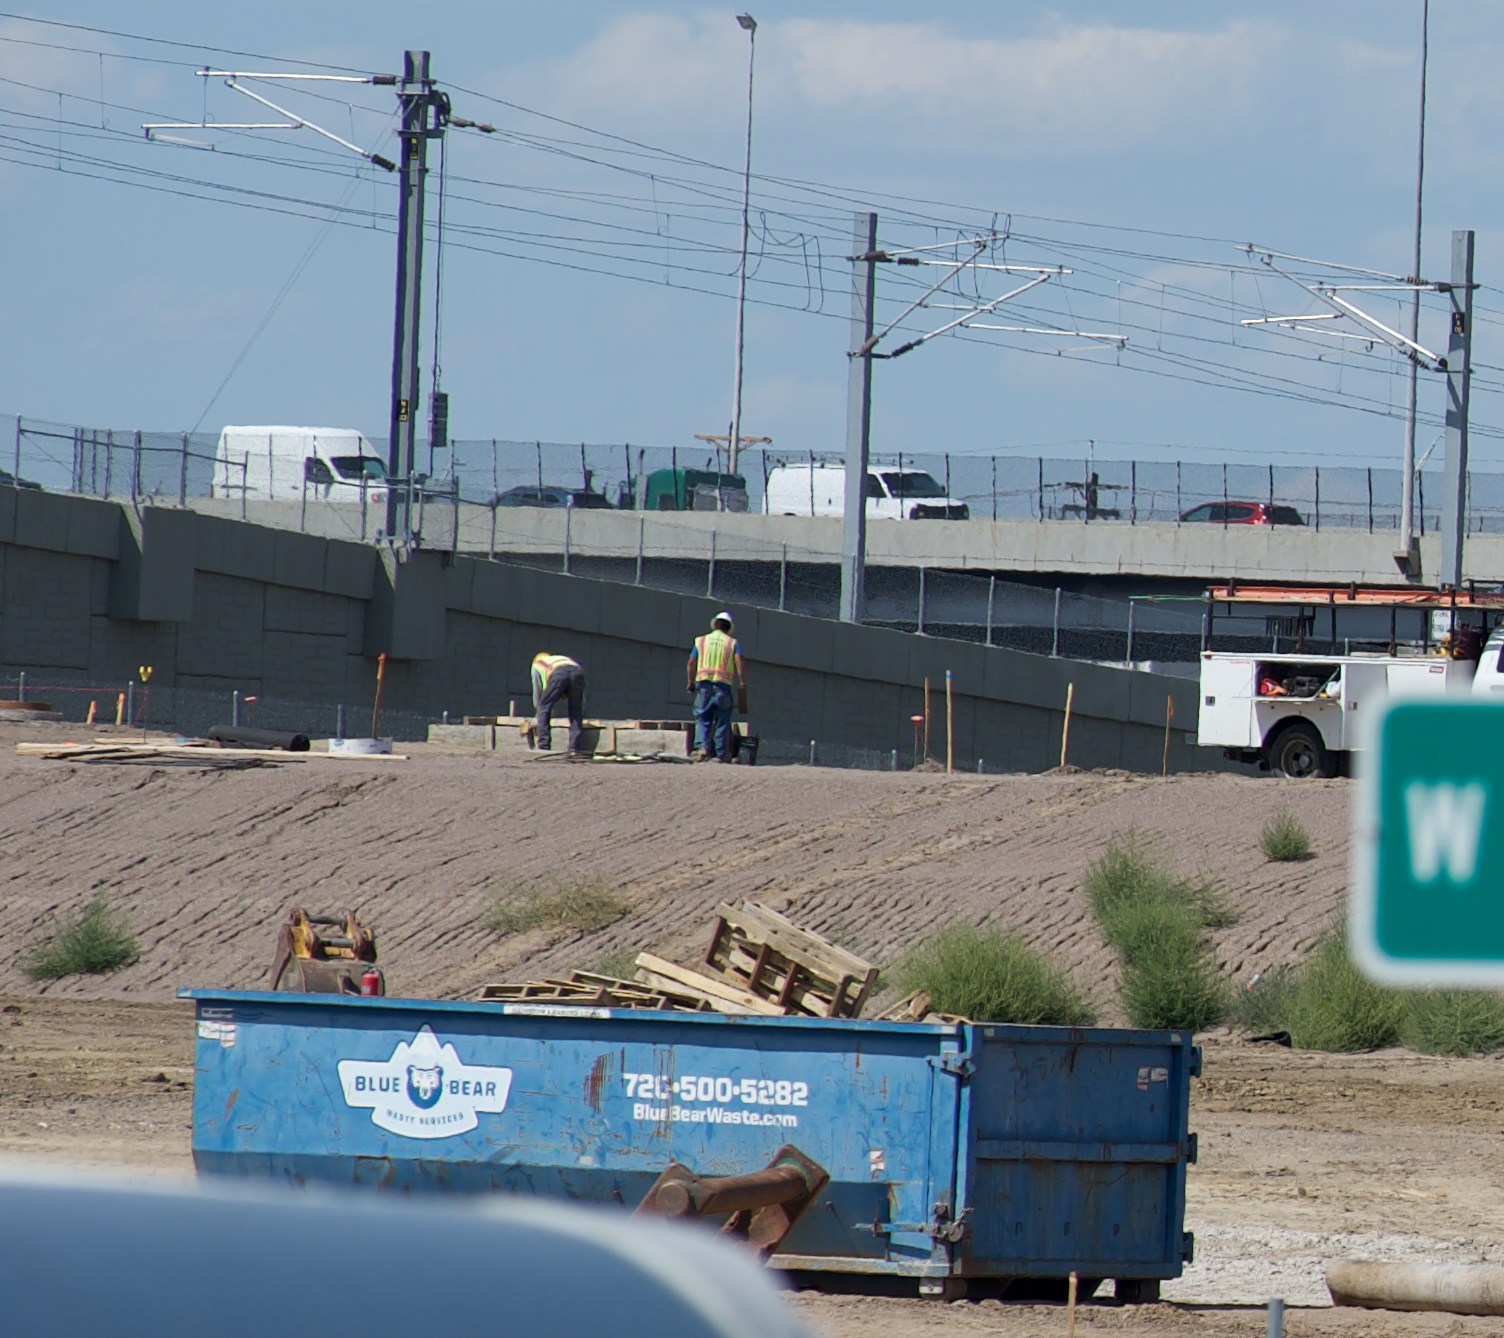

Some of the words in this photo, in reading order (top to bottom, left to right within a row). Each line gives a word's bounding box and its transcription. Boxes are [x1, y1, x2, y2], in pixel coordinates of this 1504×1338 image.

[1404, 779, 1486, 882] W
[355, 1076, 401, 1093] BLUE
[449, 1080, 496, 1097] BEAR
[386, 1109, 415, 1124] WASTE
[419, 1111, 464, 1125] SERVICES
[632, 1103, 798, 1128] BlueBearWaste.com
